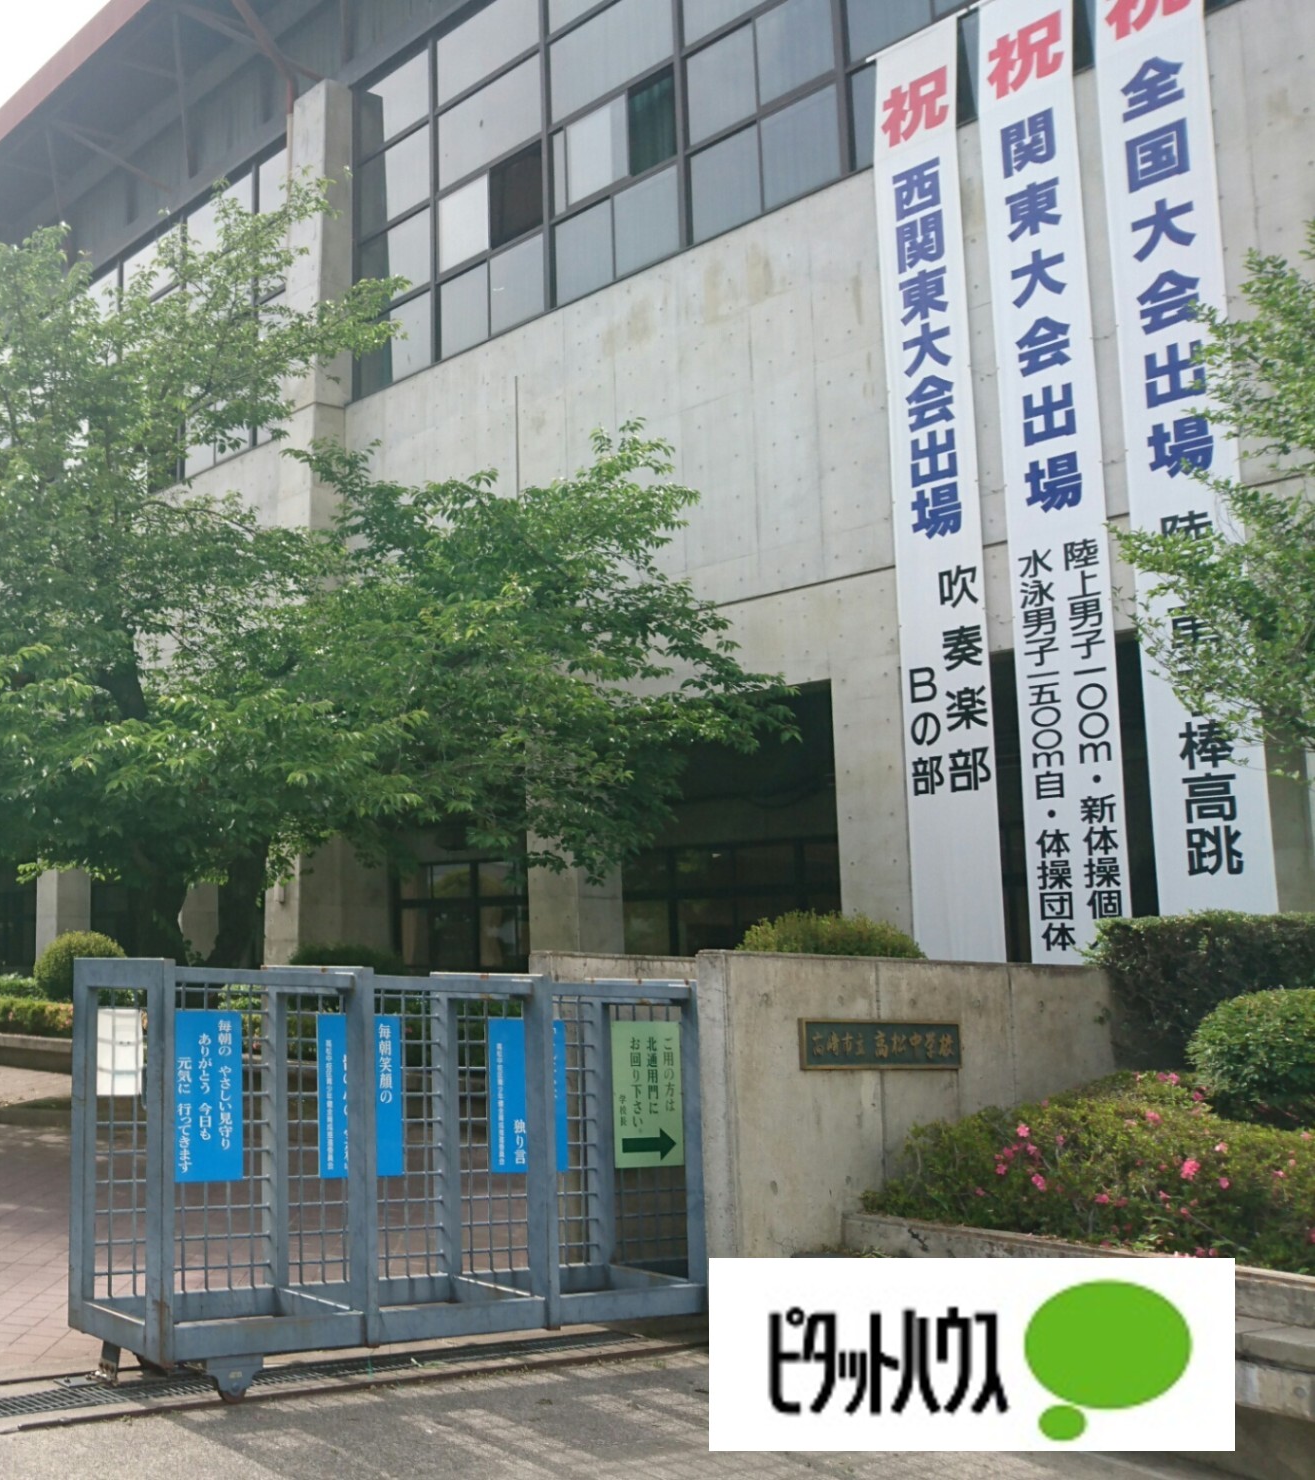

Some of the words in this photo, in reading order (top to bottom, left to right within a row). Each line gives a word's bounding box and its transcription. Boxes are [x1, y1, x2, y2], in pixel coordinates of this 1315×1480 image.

[987, 9, 1065, 100] 祝
[880, 64, 949, 148] 祝
[1120, 56, 1215, 479] 全国大会出場
[892, 156, 963, 540] 西関東大会出場
[1000, 106, 1083, 513] 関東大会出場
[938, 564, 992, 793] 吹奏楽部
[909, 666, 944, 796] Bの部
[177, 1057, 192, 1094] 元気に
[198, 1033, 212, 1095] ありがとう
[218, 1020, 232, 1056] 毎朝の
[378, 1023, 393, 1104] 毎朝笑顔の
[646, 1036, 659, 1115] 北通用門に
[177, 1103, 192, 1173] 行ってきます
[198, 1102, 212, 1141] 今日も
[218, 1066, 232, 1150] やさしい見守り
[514, 1119, 526, 1165] 独り言
[618, 1094, 627, 1127] 学校長
